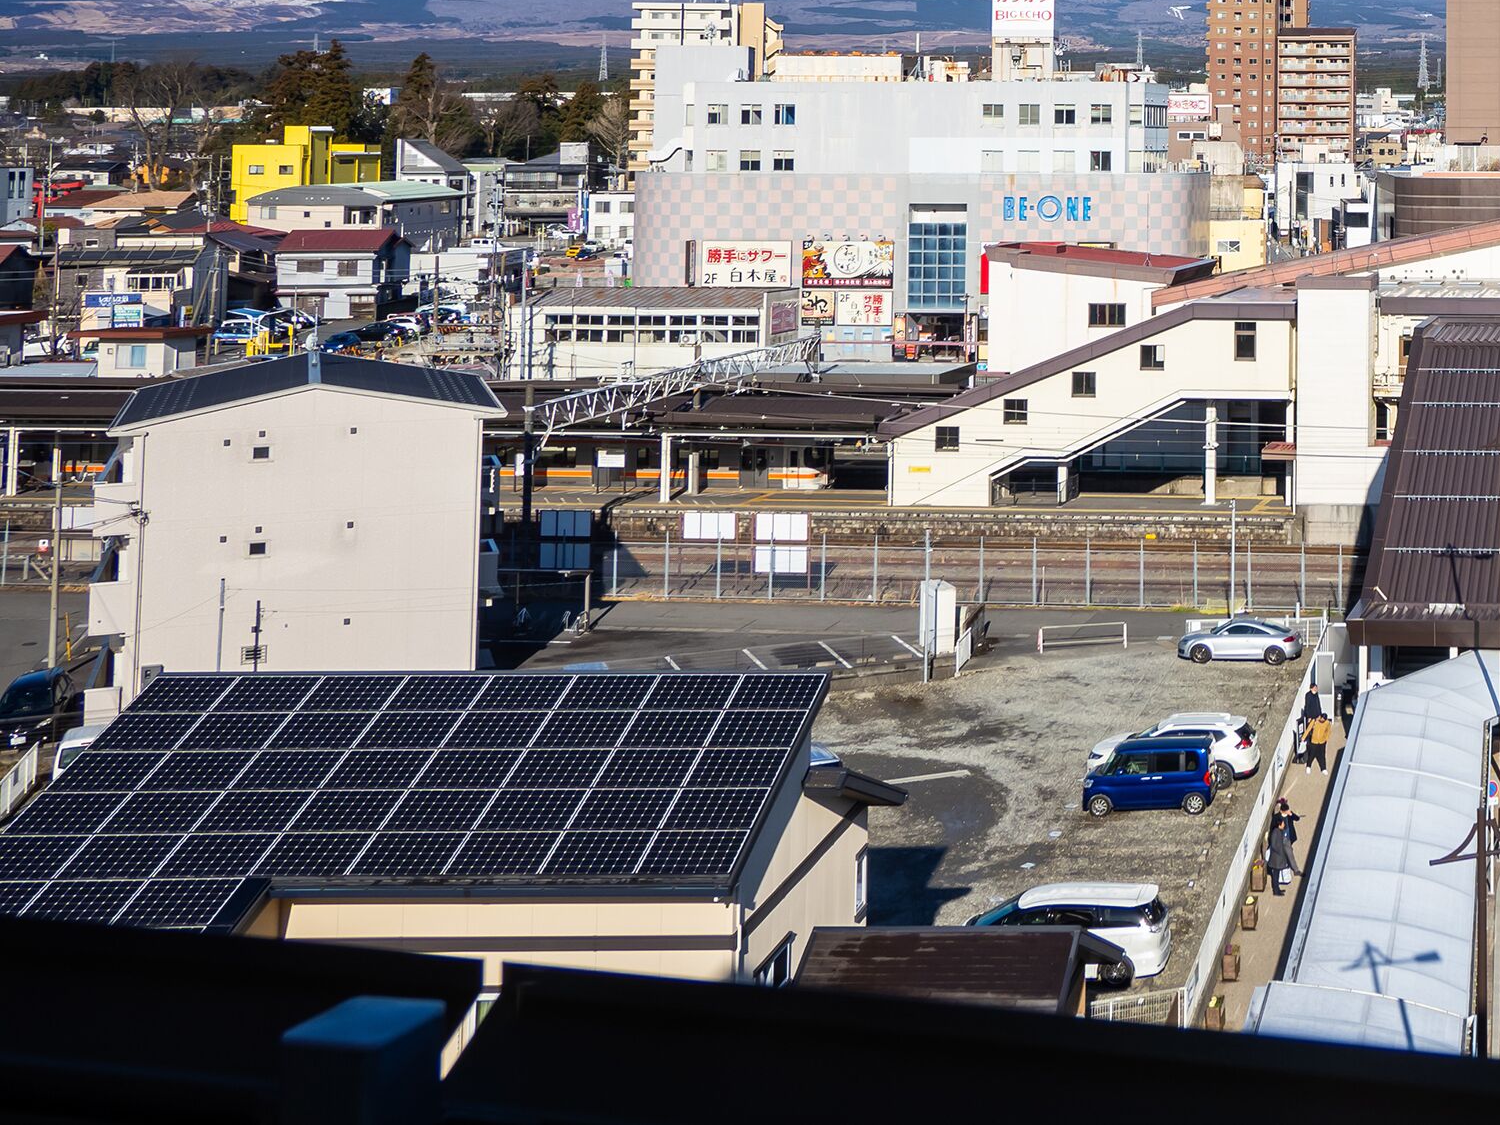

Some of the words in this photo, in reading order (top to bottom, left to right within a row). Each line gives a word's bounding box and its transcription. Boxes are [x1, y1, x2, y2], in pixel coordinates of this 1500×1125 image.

[707, 249, 786, 263] 勝手にサワー
[704, 273, 718, 284] 2F
[730, 267, 778, 283] 白木屋
[840, 294, 850, 302] 2F
[872, 294, 883, 323] 勝手に
